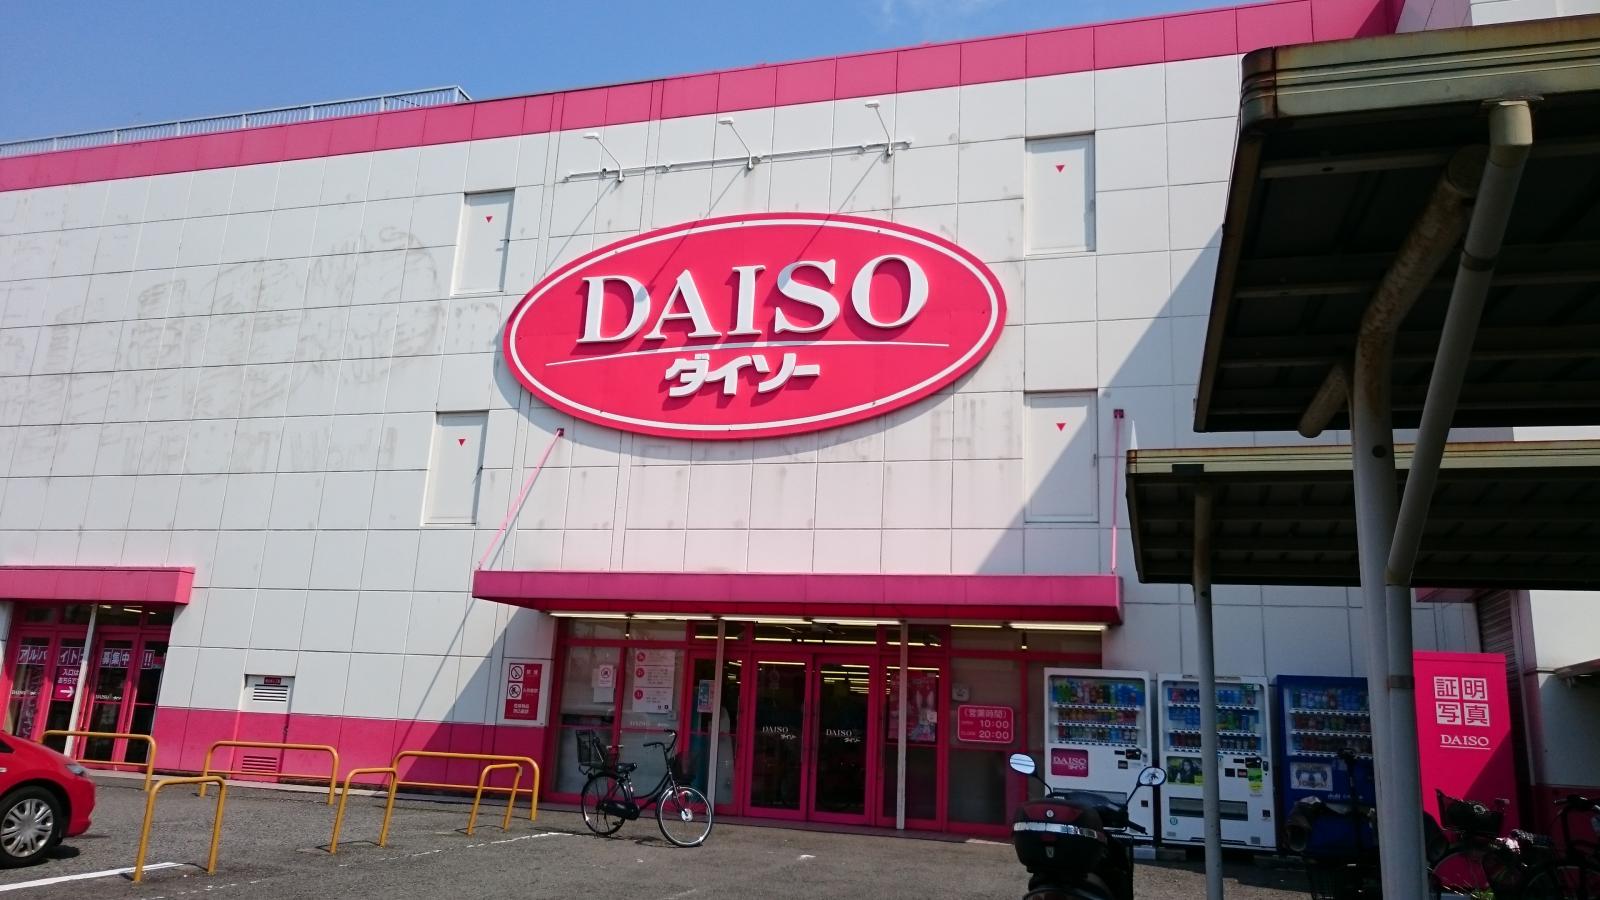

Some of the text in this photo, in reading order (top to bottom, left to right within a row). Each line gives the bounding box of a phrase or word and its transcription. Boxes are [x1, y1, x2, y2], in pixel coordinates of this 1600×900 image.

[576, 254, 930, 344] DAISO
[664, 352, 821, 398] ダイソー
[102, 651, 129, 666] 募集中
[1435, 677, 1487, 700] 証明
[1437, 704, 1488, 725] 写真
[980, 720, 1009, 728] 10:00
[826, 729, 852, 737] DAISO
[979, 730, 1009, 739] 20:00
[1440, 734, 1489, 746] DAISO
[1052, 756, 1087, 766] DAISO
